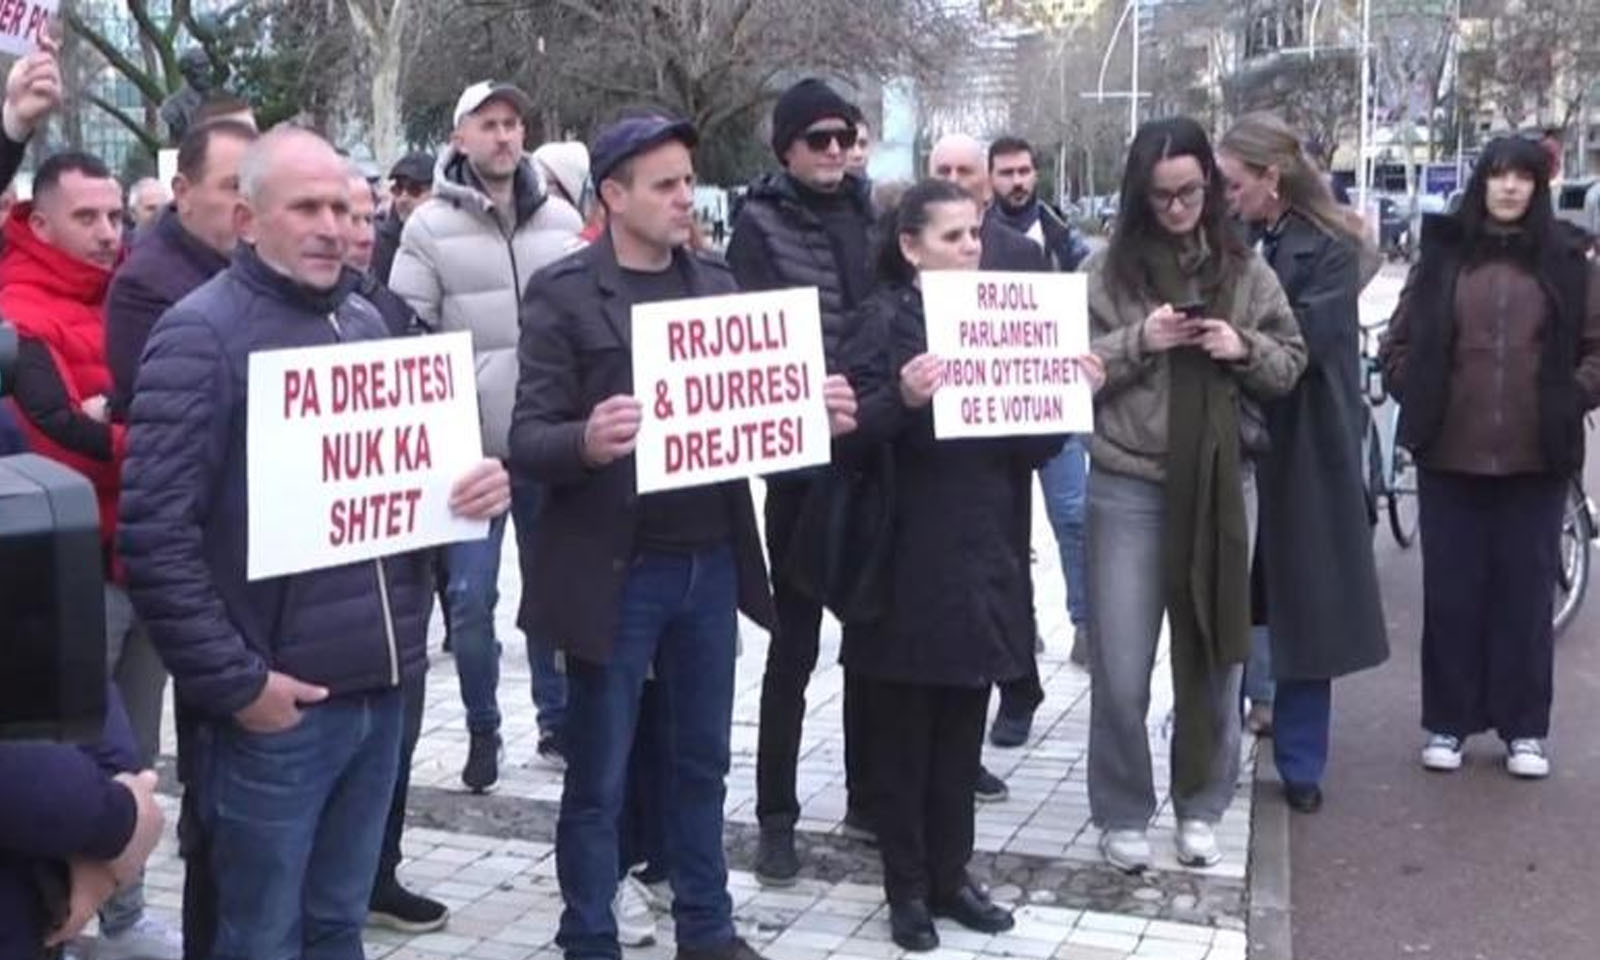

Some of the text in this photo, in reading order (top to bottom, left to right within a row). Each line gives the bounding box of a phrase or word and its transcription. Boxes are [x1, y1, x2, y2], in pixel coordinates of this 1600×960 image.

[976, 280, 1039, 311] RRJOLL
[667, 308, 788, 363] RRJOLLI
[958, 318, 1059, 348] PARLAMENTI
[283, 352, 455, 420] PA DREJTESI
[653, 361, 810, 420] & DURRESI
[960, 393, 1064, 425] QE E VOTUAN
[320, 421, 432, 484] NUK KA
[664, 416, 804, 475] DREJTESI
[328, 487, 423, 548] SHTET
